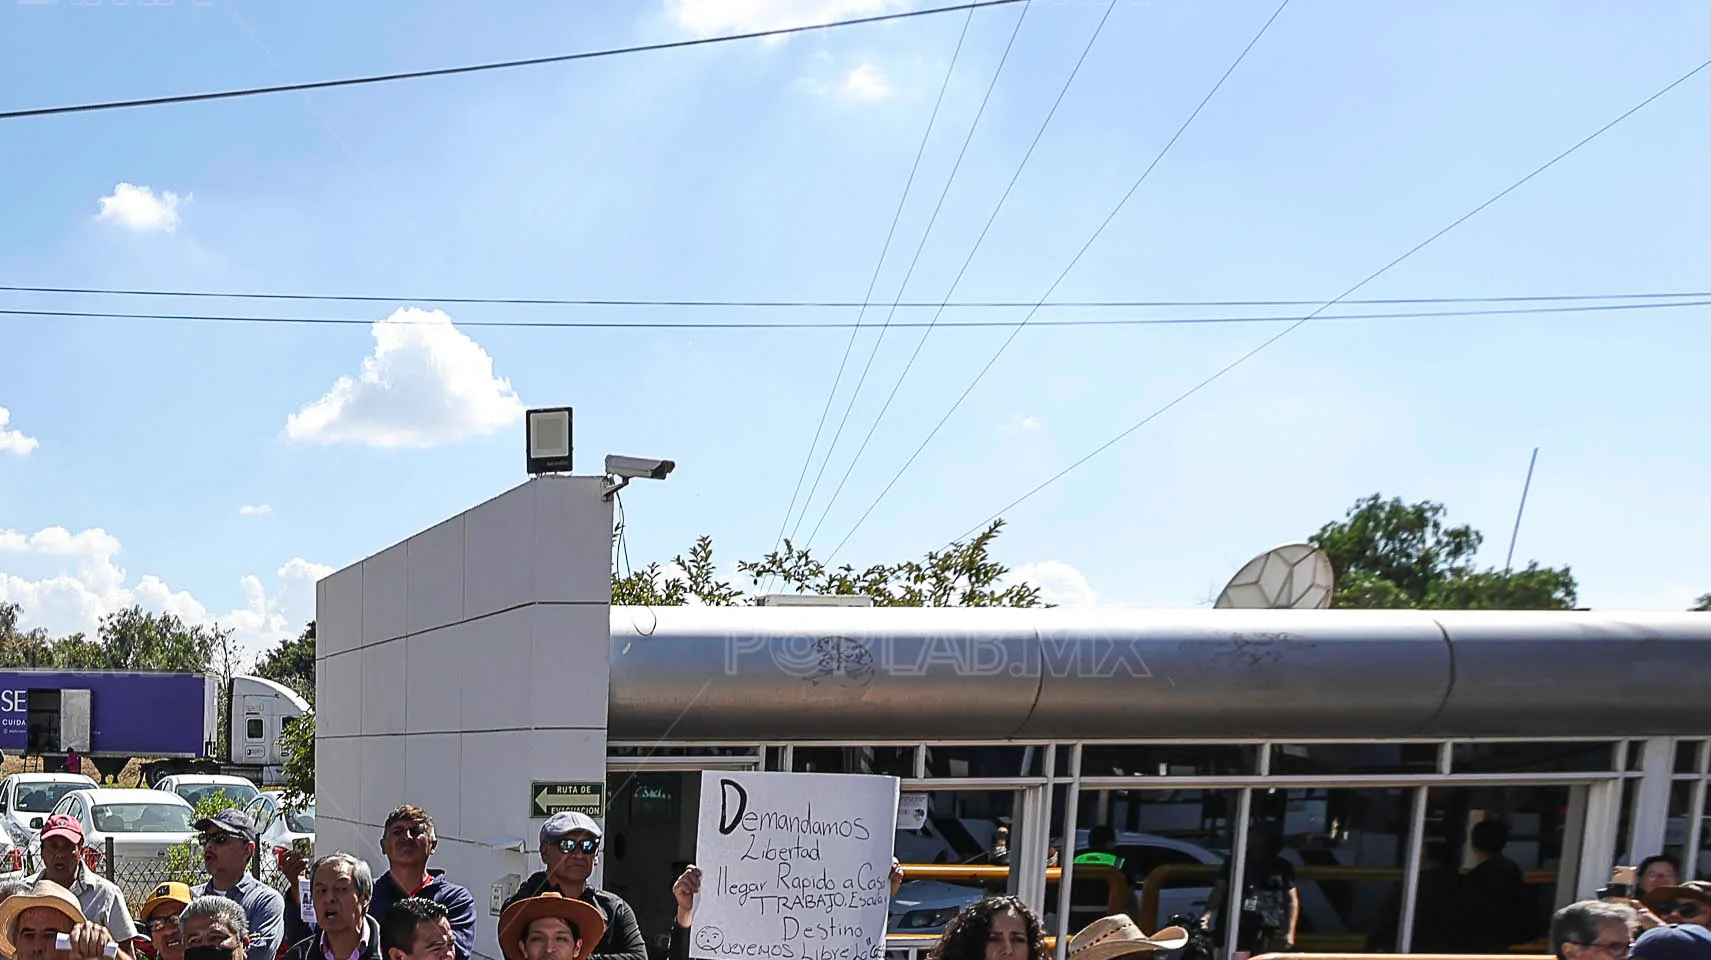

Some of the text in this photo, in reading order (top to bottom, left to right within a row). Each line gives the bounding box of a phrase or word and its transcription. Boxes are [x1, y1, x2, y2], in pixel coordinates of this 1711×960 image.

[556, 786, 591, 794] RUTA DE
[719, 779, 870, 841] Demandamos
[842, 878, 854, 889] a
